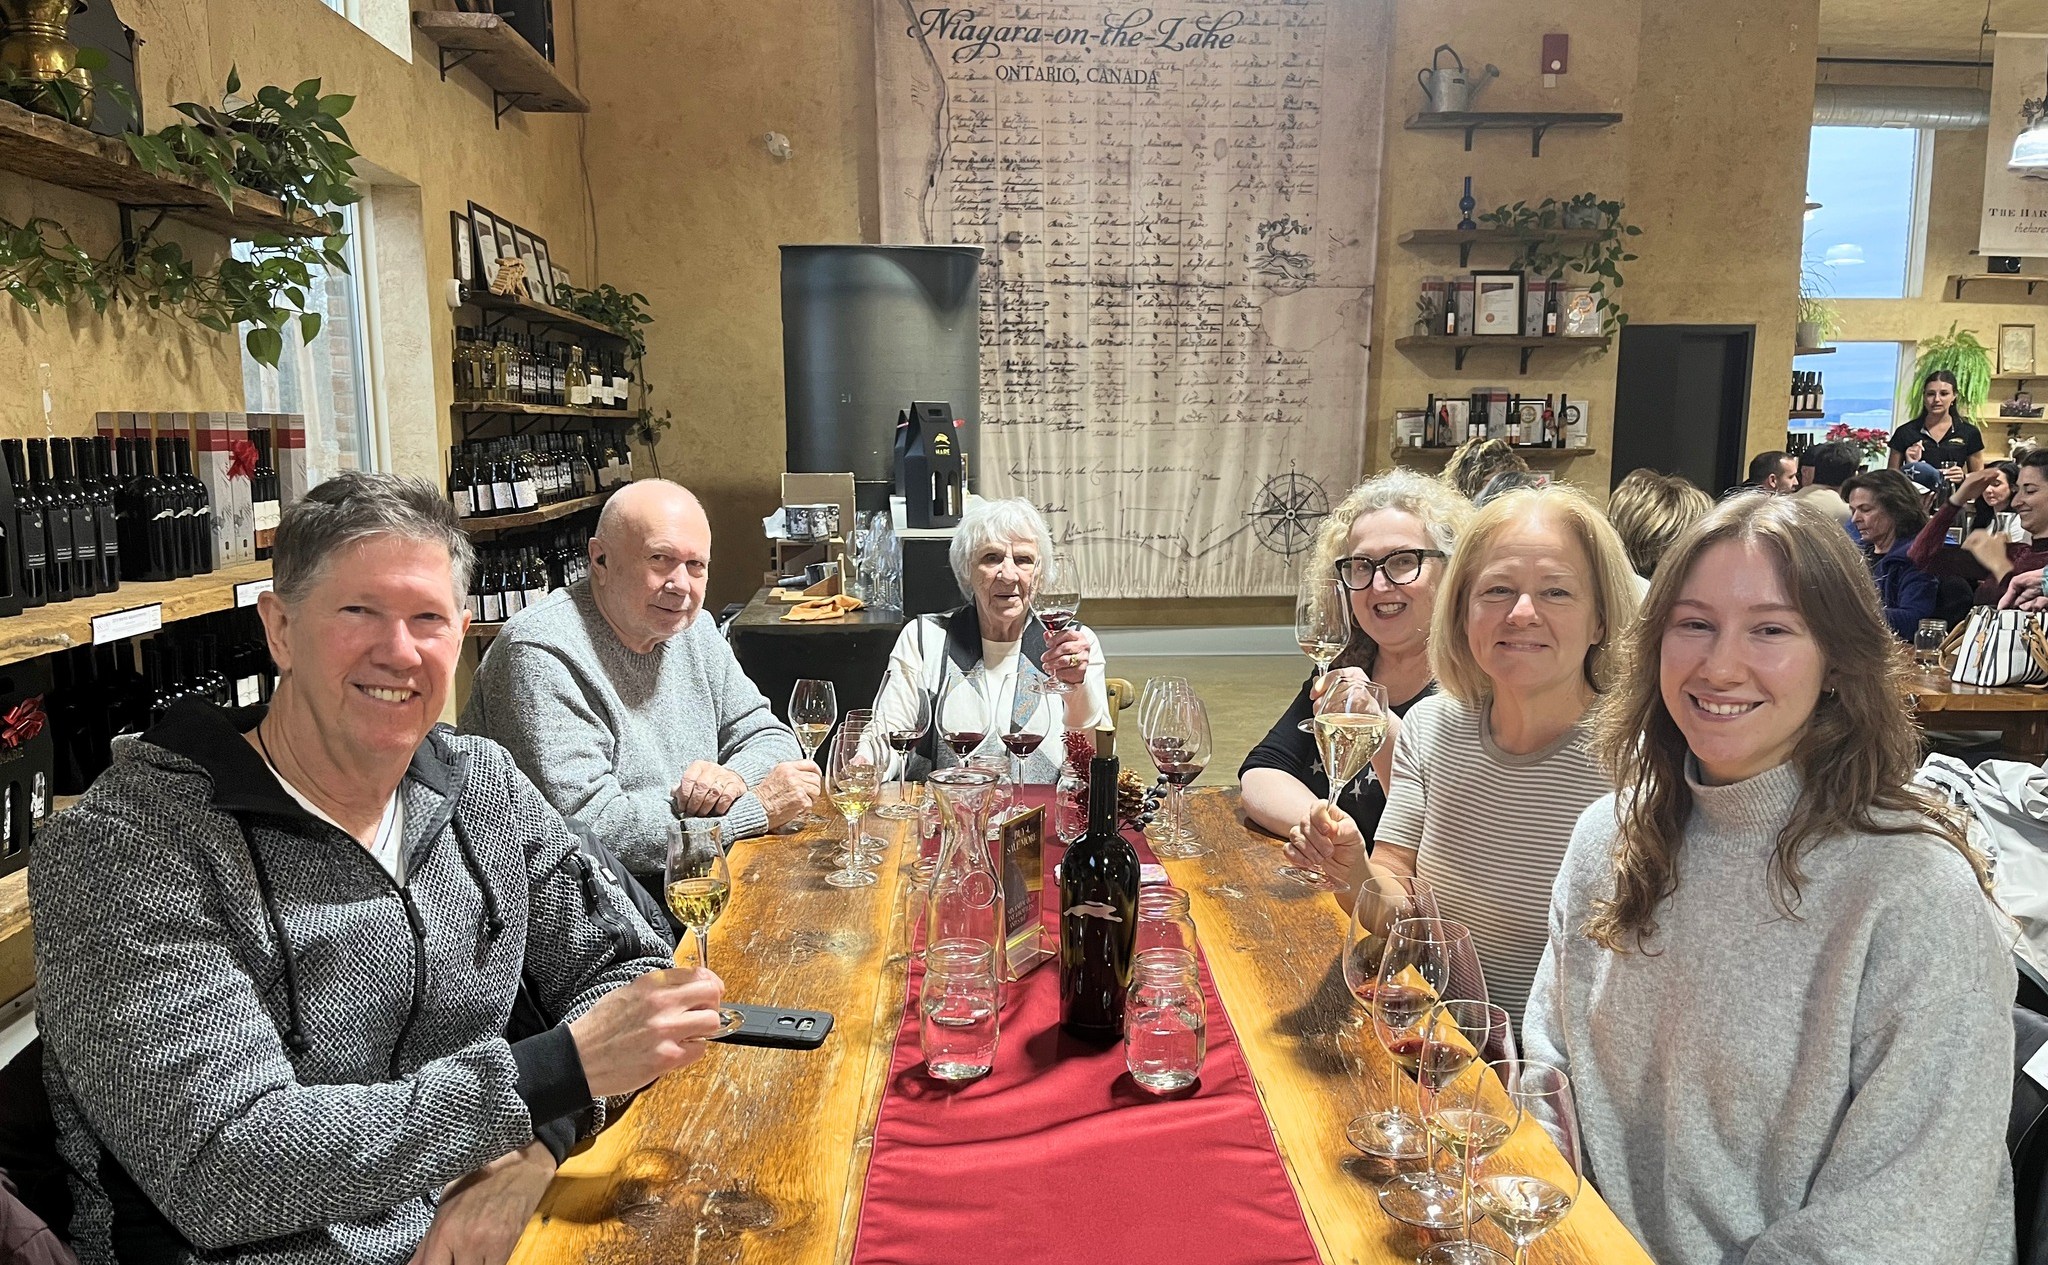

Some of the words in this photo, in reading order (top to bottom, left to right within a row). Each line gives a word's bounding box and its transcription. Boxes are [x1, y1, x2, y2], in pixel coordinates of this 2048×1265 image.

[907, 8, 1244, 63] Niagara-on-the-Lake
[996, 66, 1080, 85] ONTARIO,
[1087, 69, 1159, 85] CANADA
[1988, 208, 2016, 217] THE
[1289, 458, 1297, 468] S
